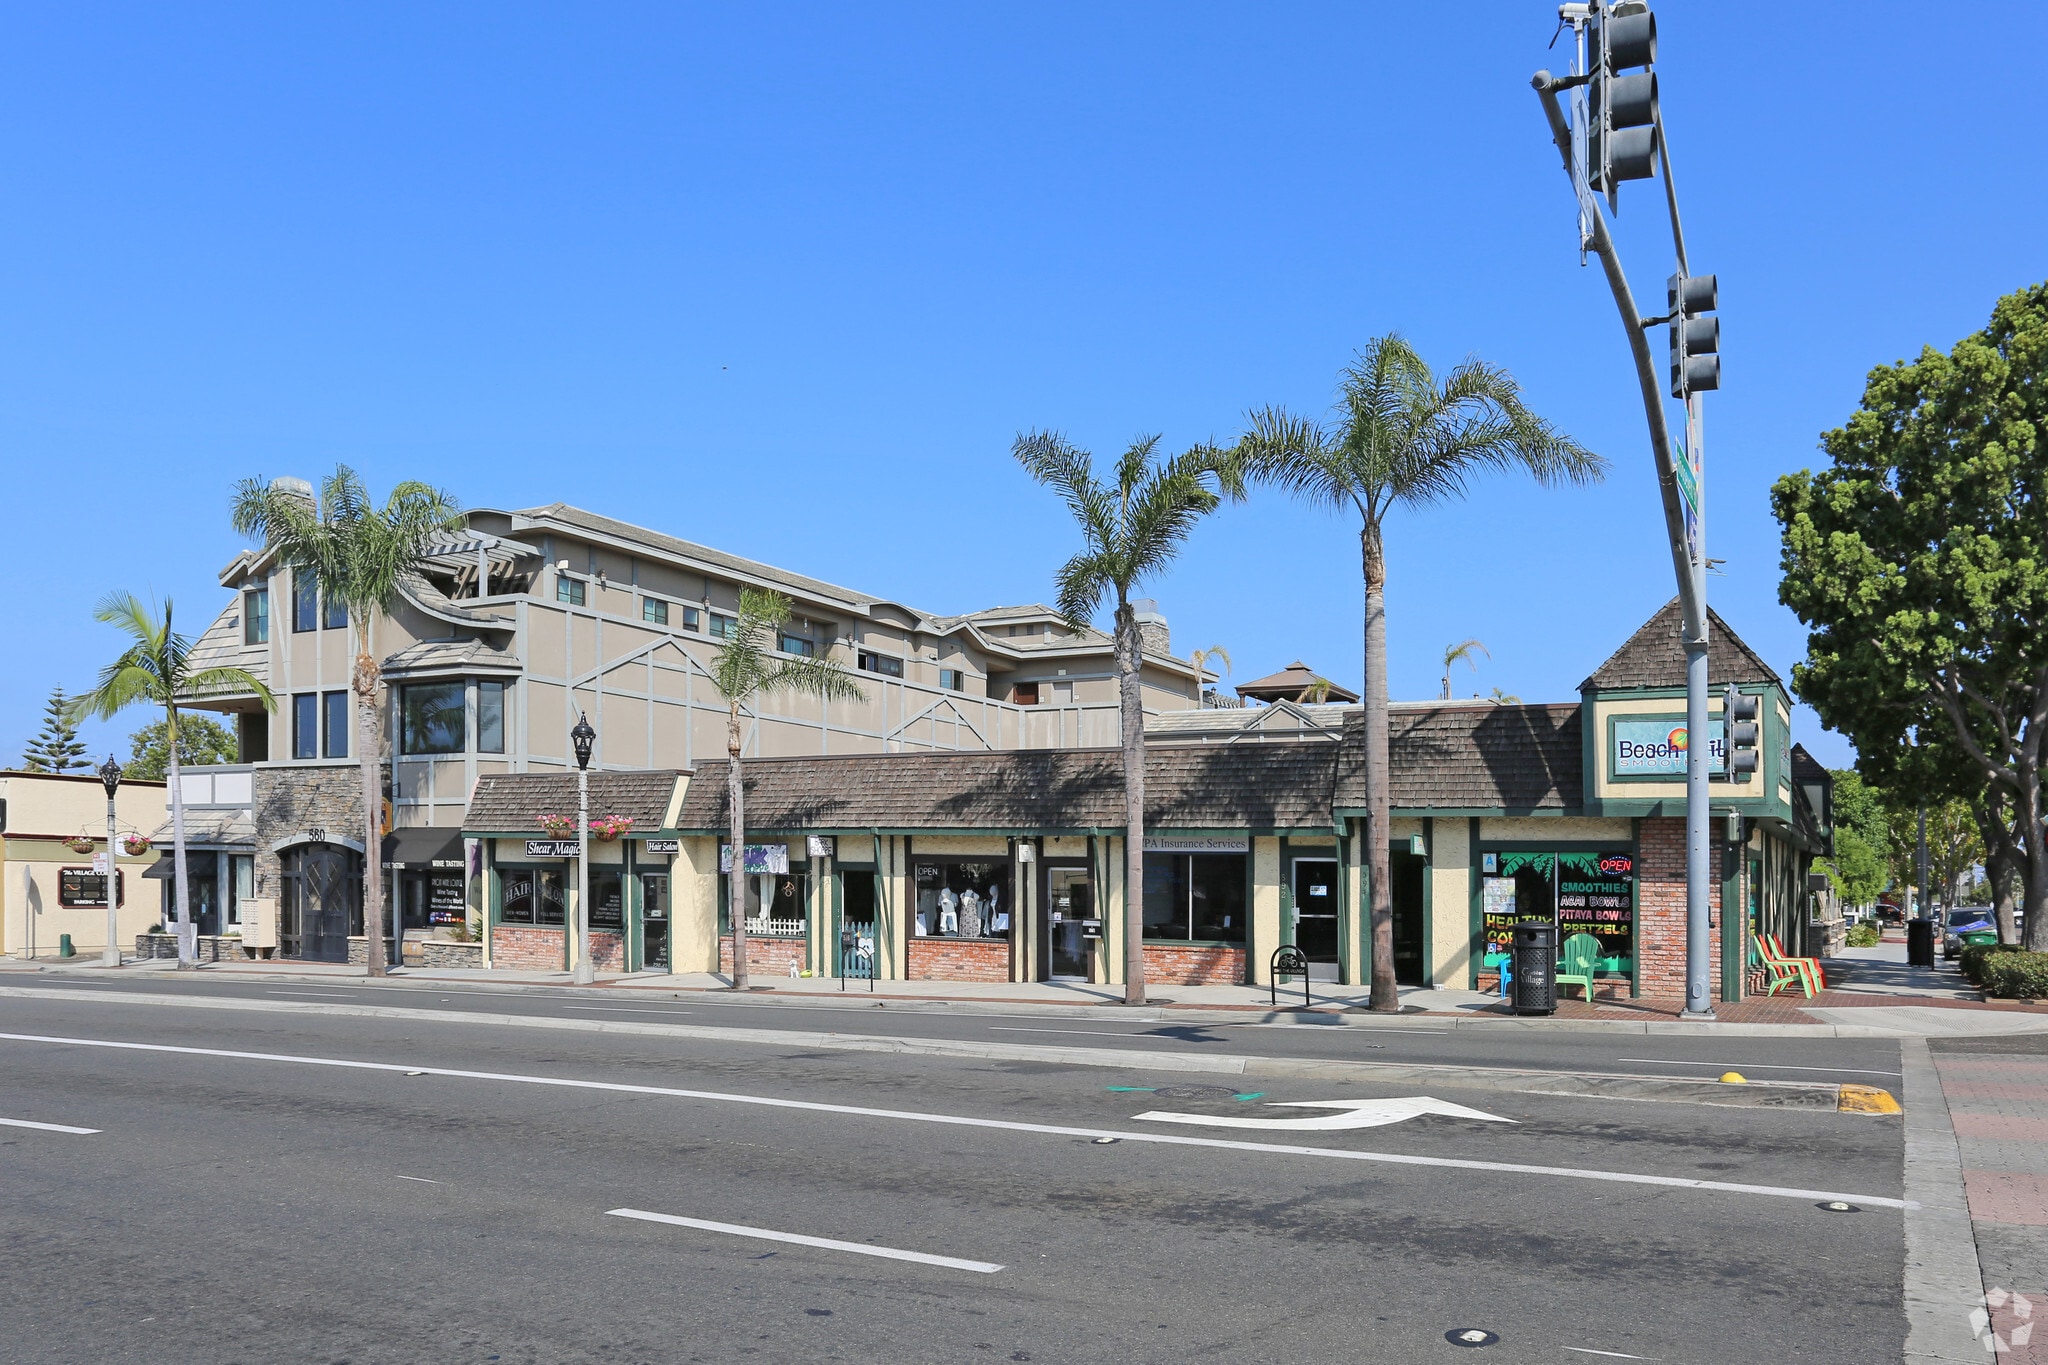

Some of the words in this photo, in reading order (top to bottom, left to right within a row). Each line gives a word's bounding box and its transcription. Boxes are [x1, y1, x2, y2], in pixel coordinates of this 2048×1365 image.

[1619, 739, 1679, 759] Beach
[309, 829, 325, 841] 560
[527, 842, 552, 855] Shear
[551, 842, 581, 857] Magic
[648, 842, 662, 851] Hair
[662, 842, 678, 851] Salon
[1161, 839, 1204, 848] Insurance
[1207, 839, 1246, 848] Services
[445, 860, 465, 868] TASTING
[1486, 856, 1493, 866] A
[1601, 859, 1632, 871] OPEN
[918, 867, 938, 876] OPEN
[505, 883, 532, 903] HAIR
[1561, 883, 1628, 893] SMOOTHIES
[1589, 896, 1630, 908] BOWLS
[1559, 909, 1593, 920] PITAYA
[1595, 910, 1632, 921] BOWLS
[1563, 923, 1629, 935] PRETZELS
